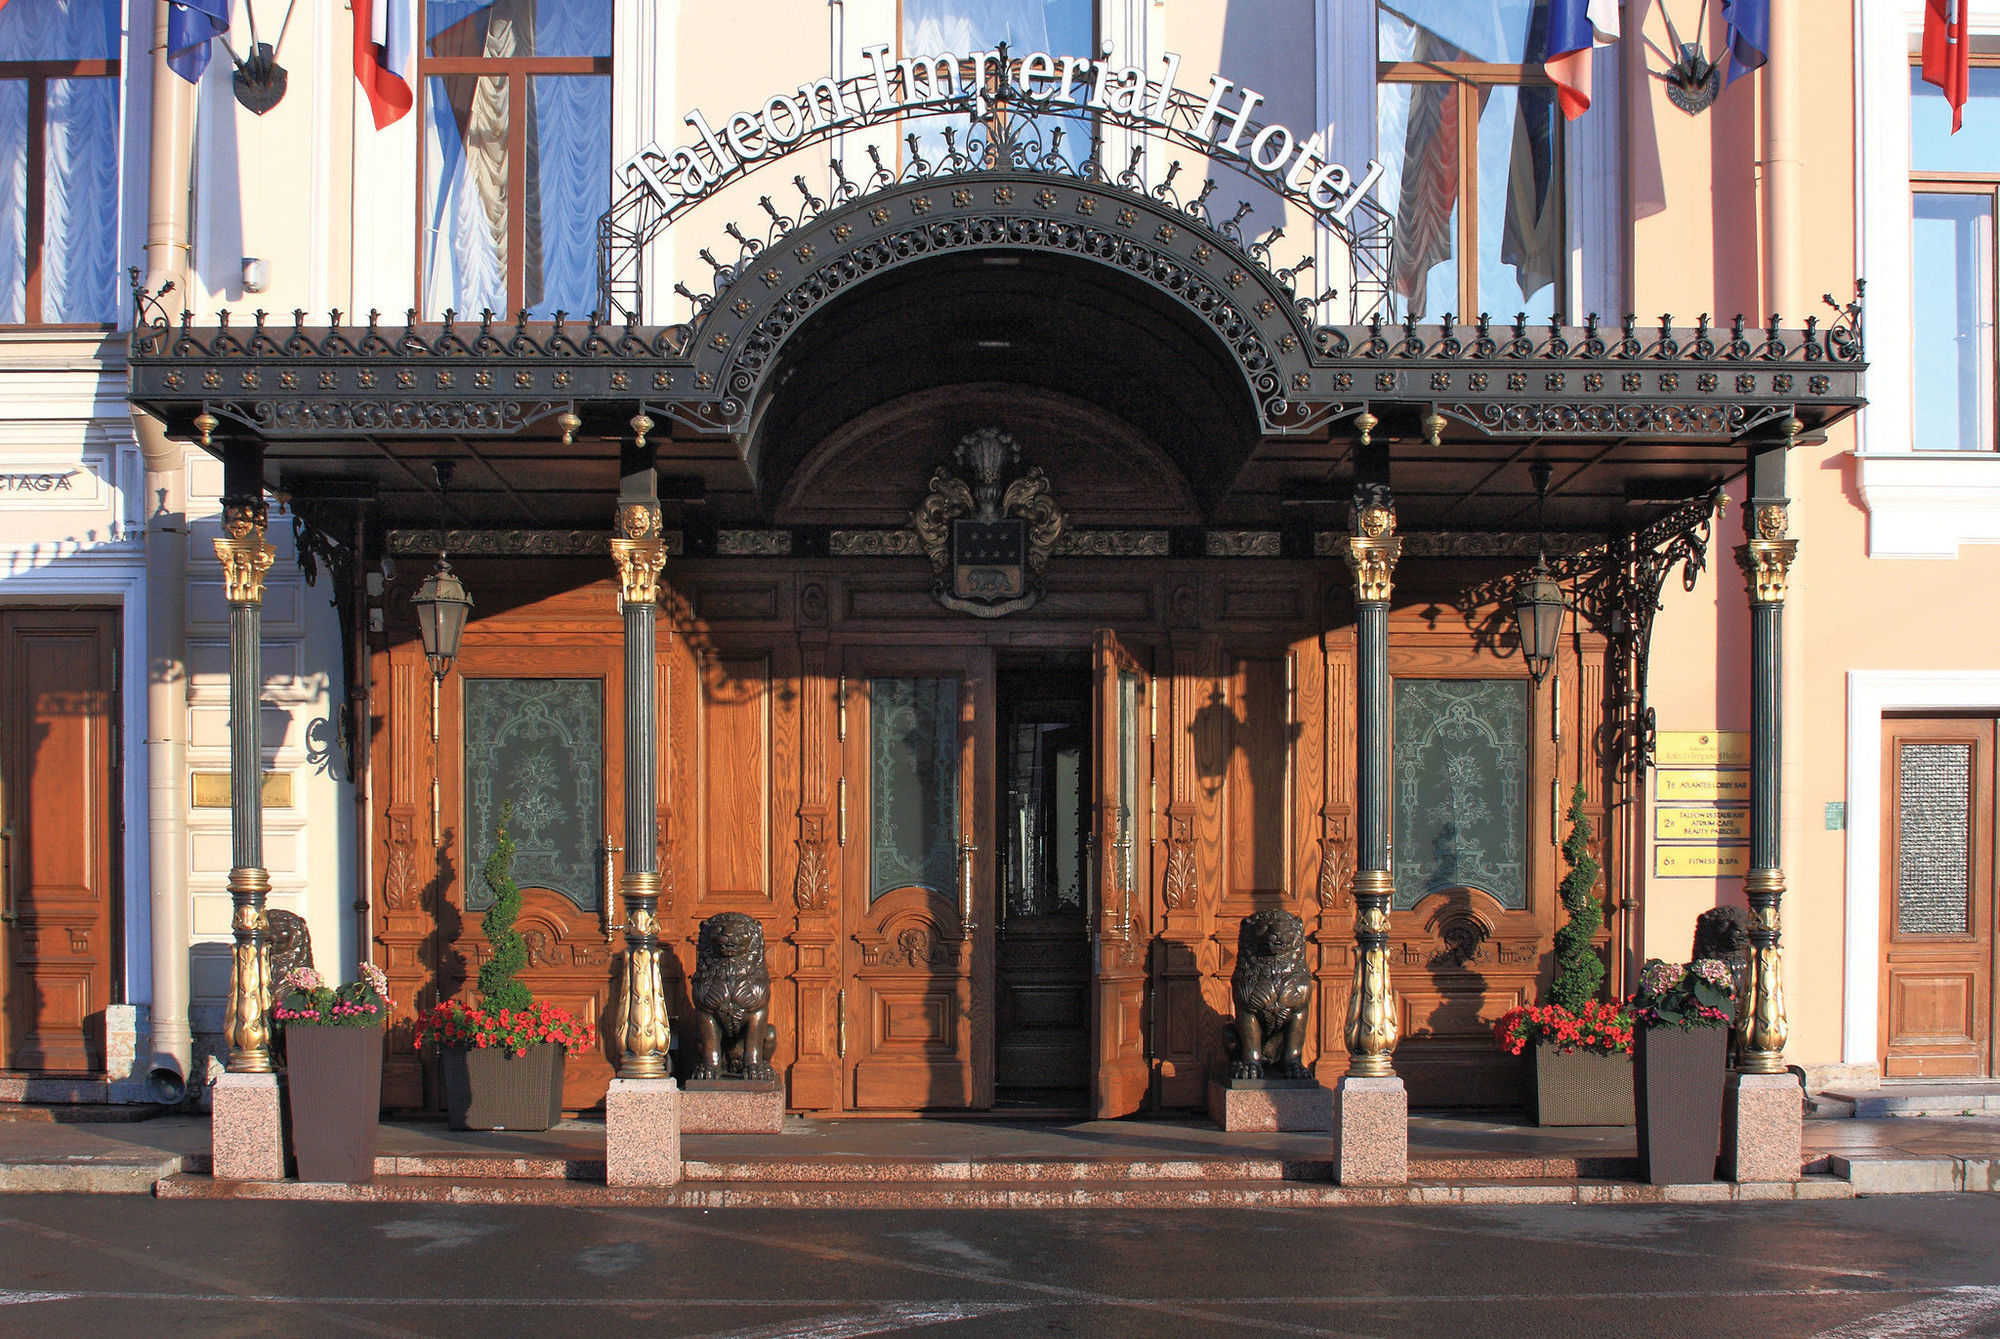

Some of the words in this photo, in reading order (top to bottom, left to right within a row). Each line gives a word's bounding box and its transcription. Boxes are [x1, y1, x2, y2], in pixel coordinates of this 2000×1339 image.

[615, 76, 855, 216] Taleon
[861, 40, 1182, 124] Imperial
[1187, 73, 1385, 229] Hotel
